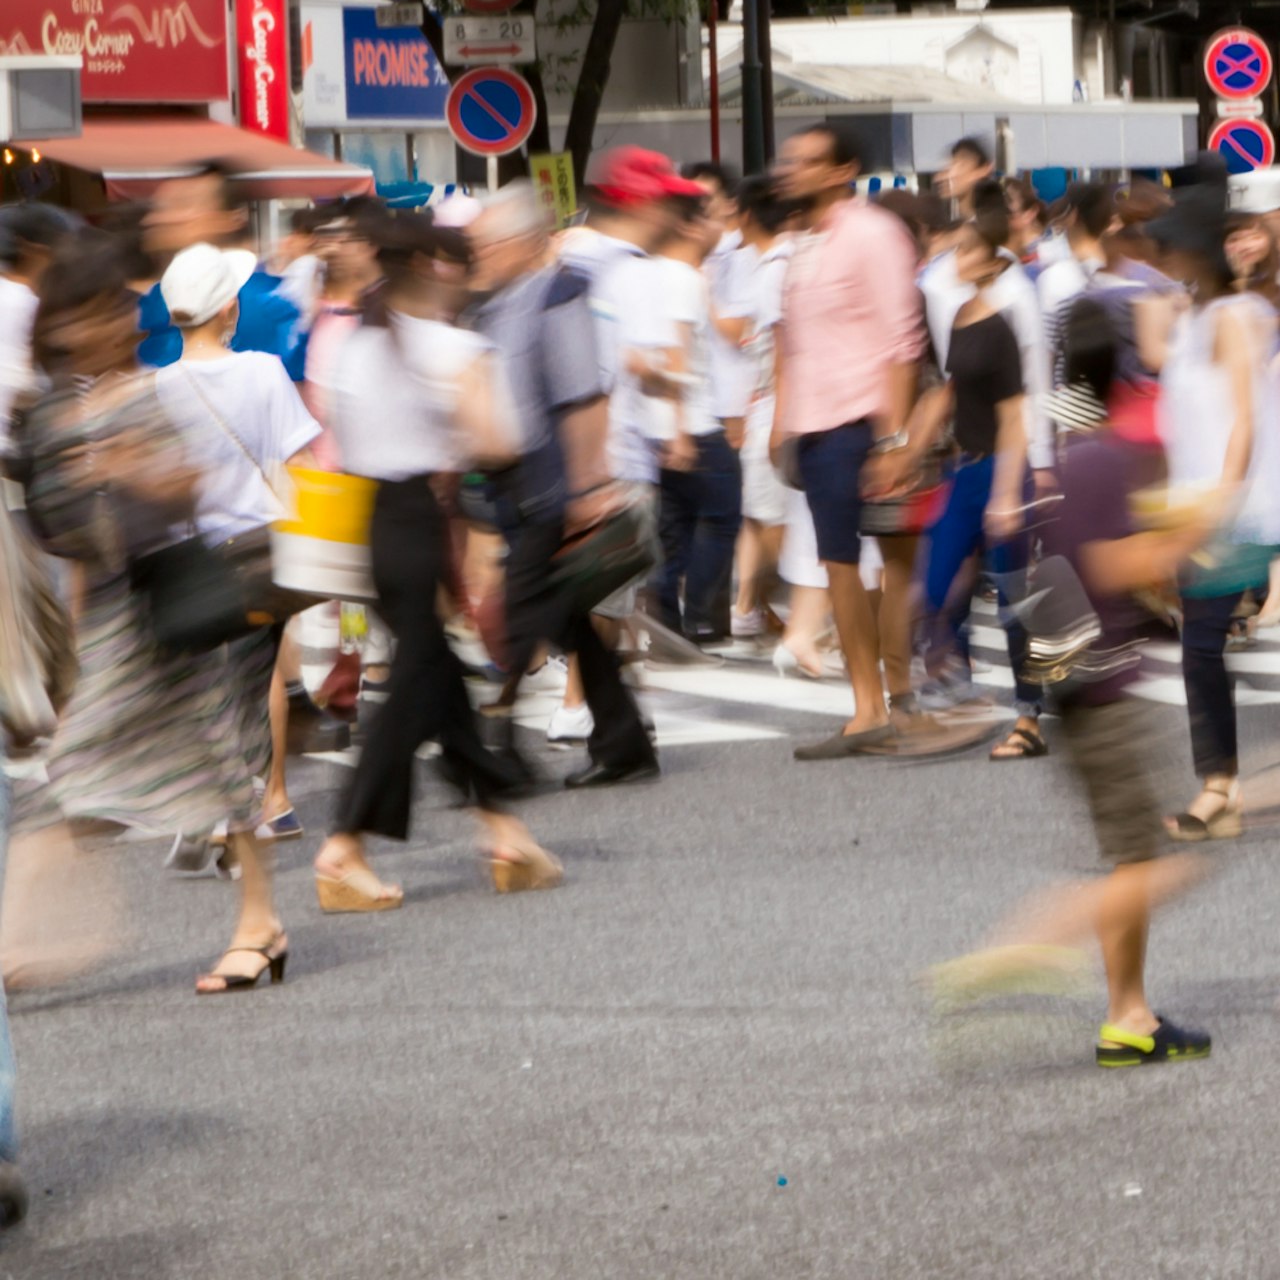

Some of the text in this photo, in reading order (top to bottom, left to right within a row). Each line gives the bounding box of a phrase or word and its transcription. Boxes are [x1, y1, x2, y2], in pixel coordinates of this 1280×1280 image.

[84, 19, 135, 57] Corner
[456, 24, 466, 40] 8
[501, 22, 523, 38] 20
[353, 40, 430, 87] PROMISE
